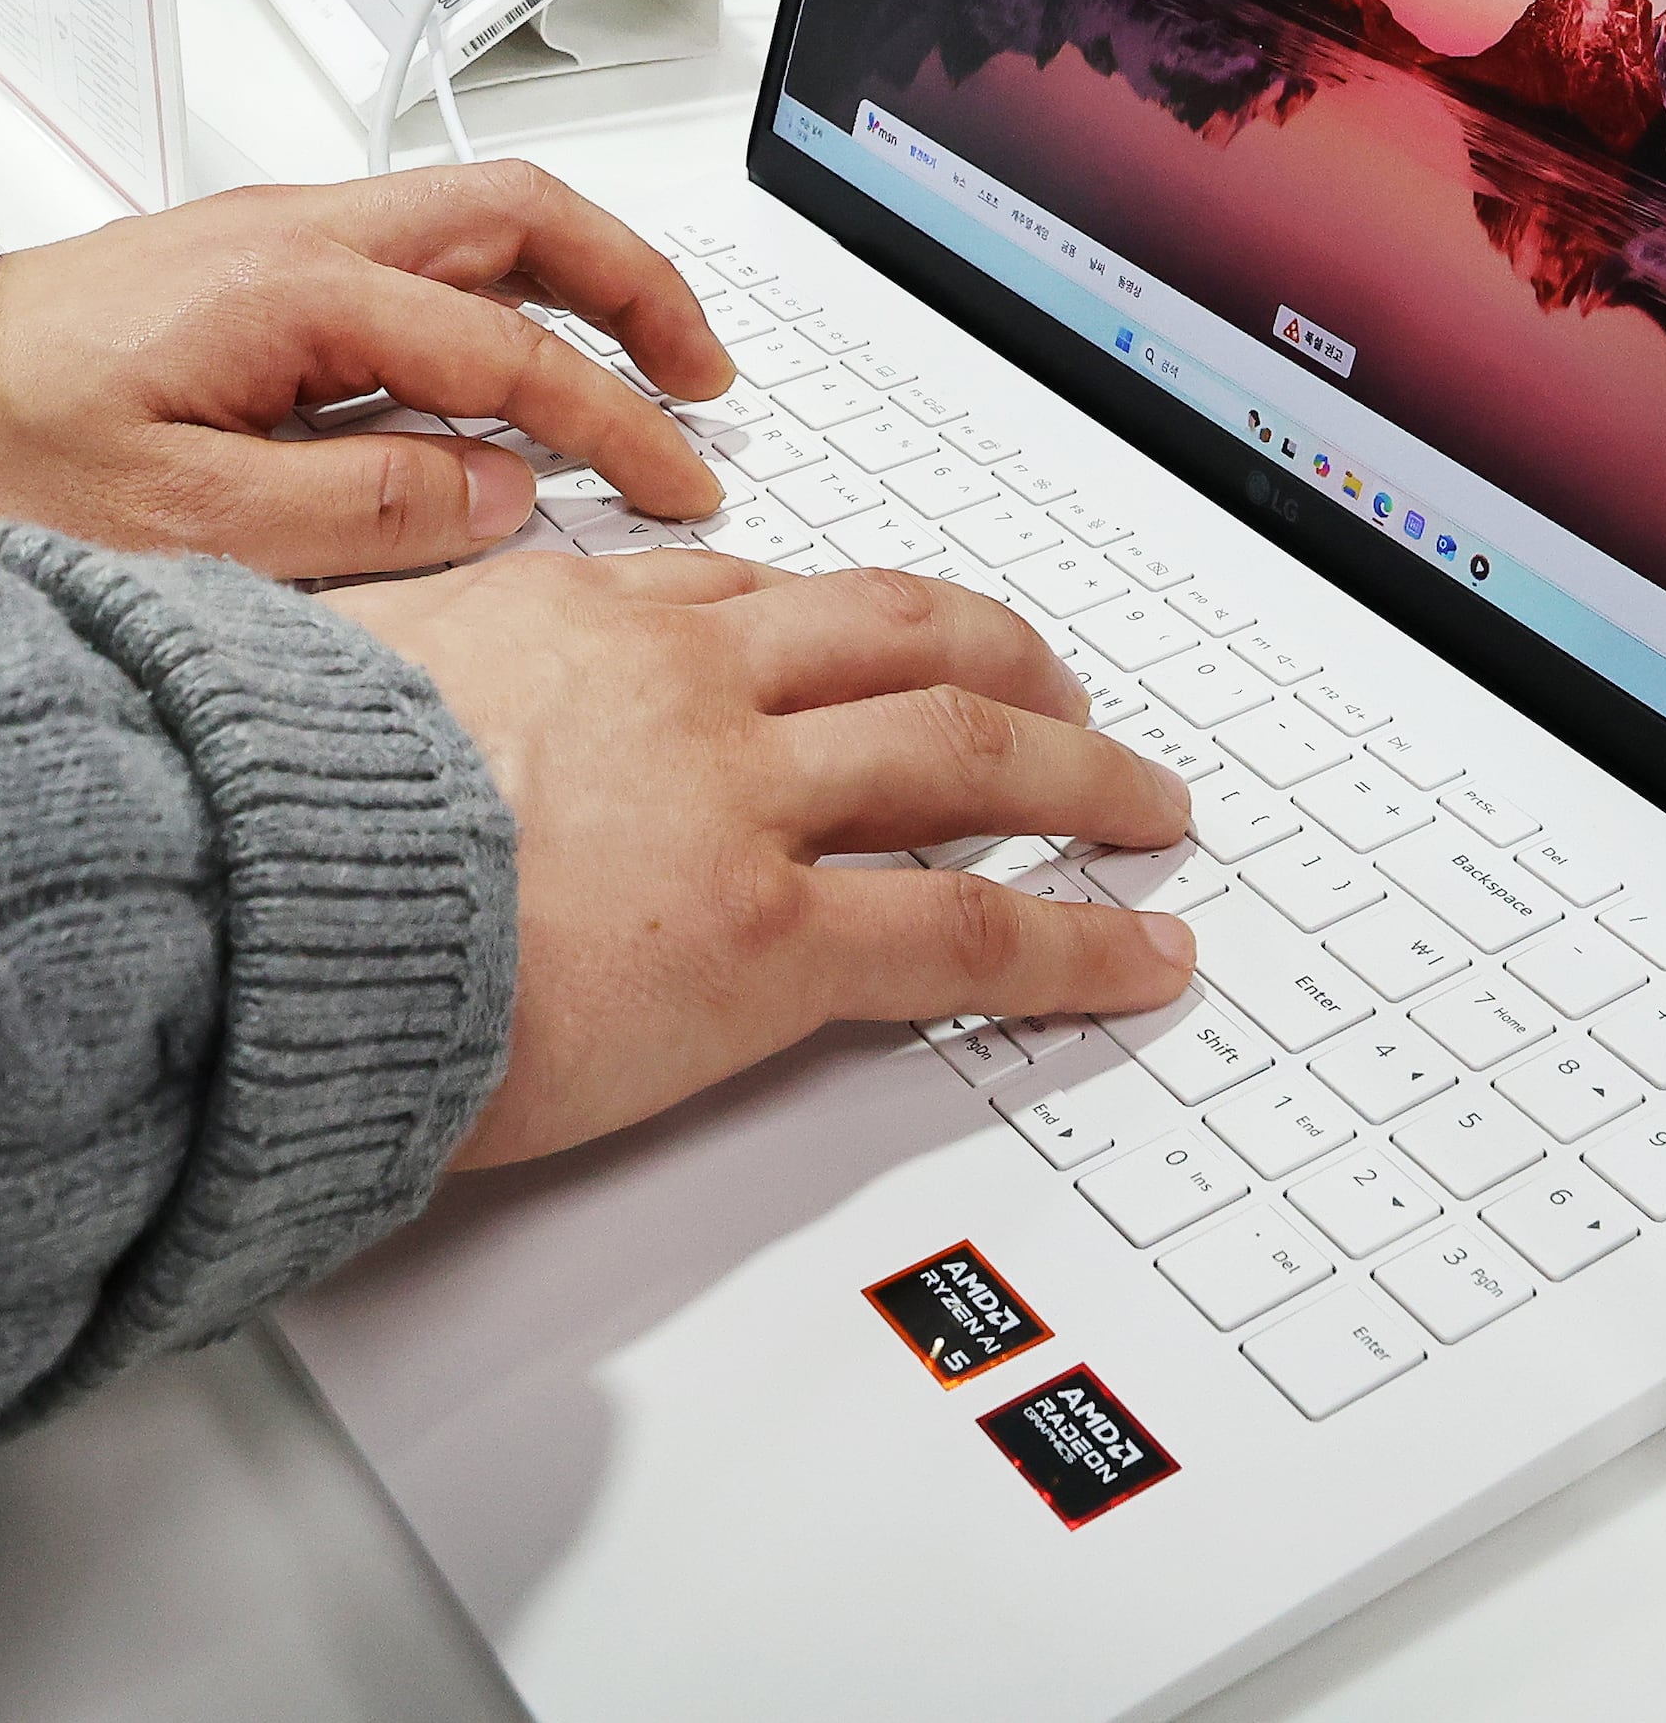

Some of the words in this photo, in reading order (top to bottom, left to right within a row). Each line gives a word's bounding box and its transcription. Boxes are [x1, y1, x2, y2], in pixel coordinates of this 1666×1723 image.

[877, 127, 899, 147] msn
[1117, 274, 1143, 299] 동영상
[1160, 358, 1180, 379] 검색
[1269, 484, 1300, 523] LG
[1463, 789, 1500, 817] PrtSc
[1540, 844, 1569, 867] Del
[1451, 853, 1534, 919] Backspace
[1293, 973, 1343, 1014] Enter
[1493, 1006, 1528, 1035] Home
[1196, 1026, 1242, 1066] Shift
[1031, 1101, 1061, 1127] End
[1295, 1114, 1326, 1140] End
[1189, 1171, 1214, 1194] Ins
[1271, 1248, 1301, 1276] Del
[940, 1260, 1001, 1313] AMD
[1470, 1267, 1506, 1300] PgDn
[919, 1268, 986, 1337] RYZEN
[976, 1335, 1003, 1356] AI
[1352, 1324, 1393, 1364] Enter
[943, 1349, 972, 1373] 5
[1056, 1386, 1121, 1446] AMD
[1034, 1396, 1119, 1485] RADEON
